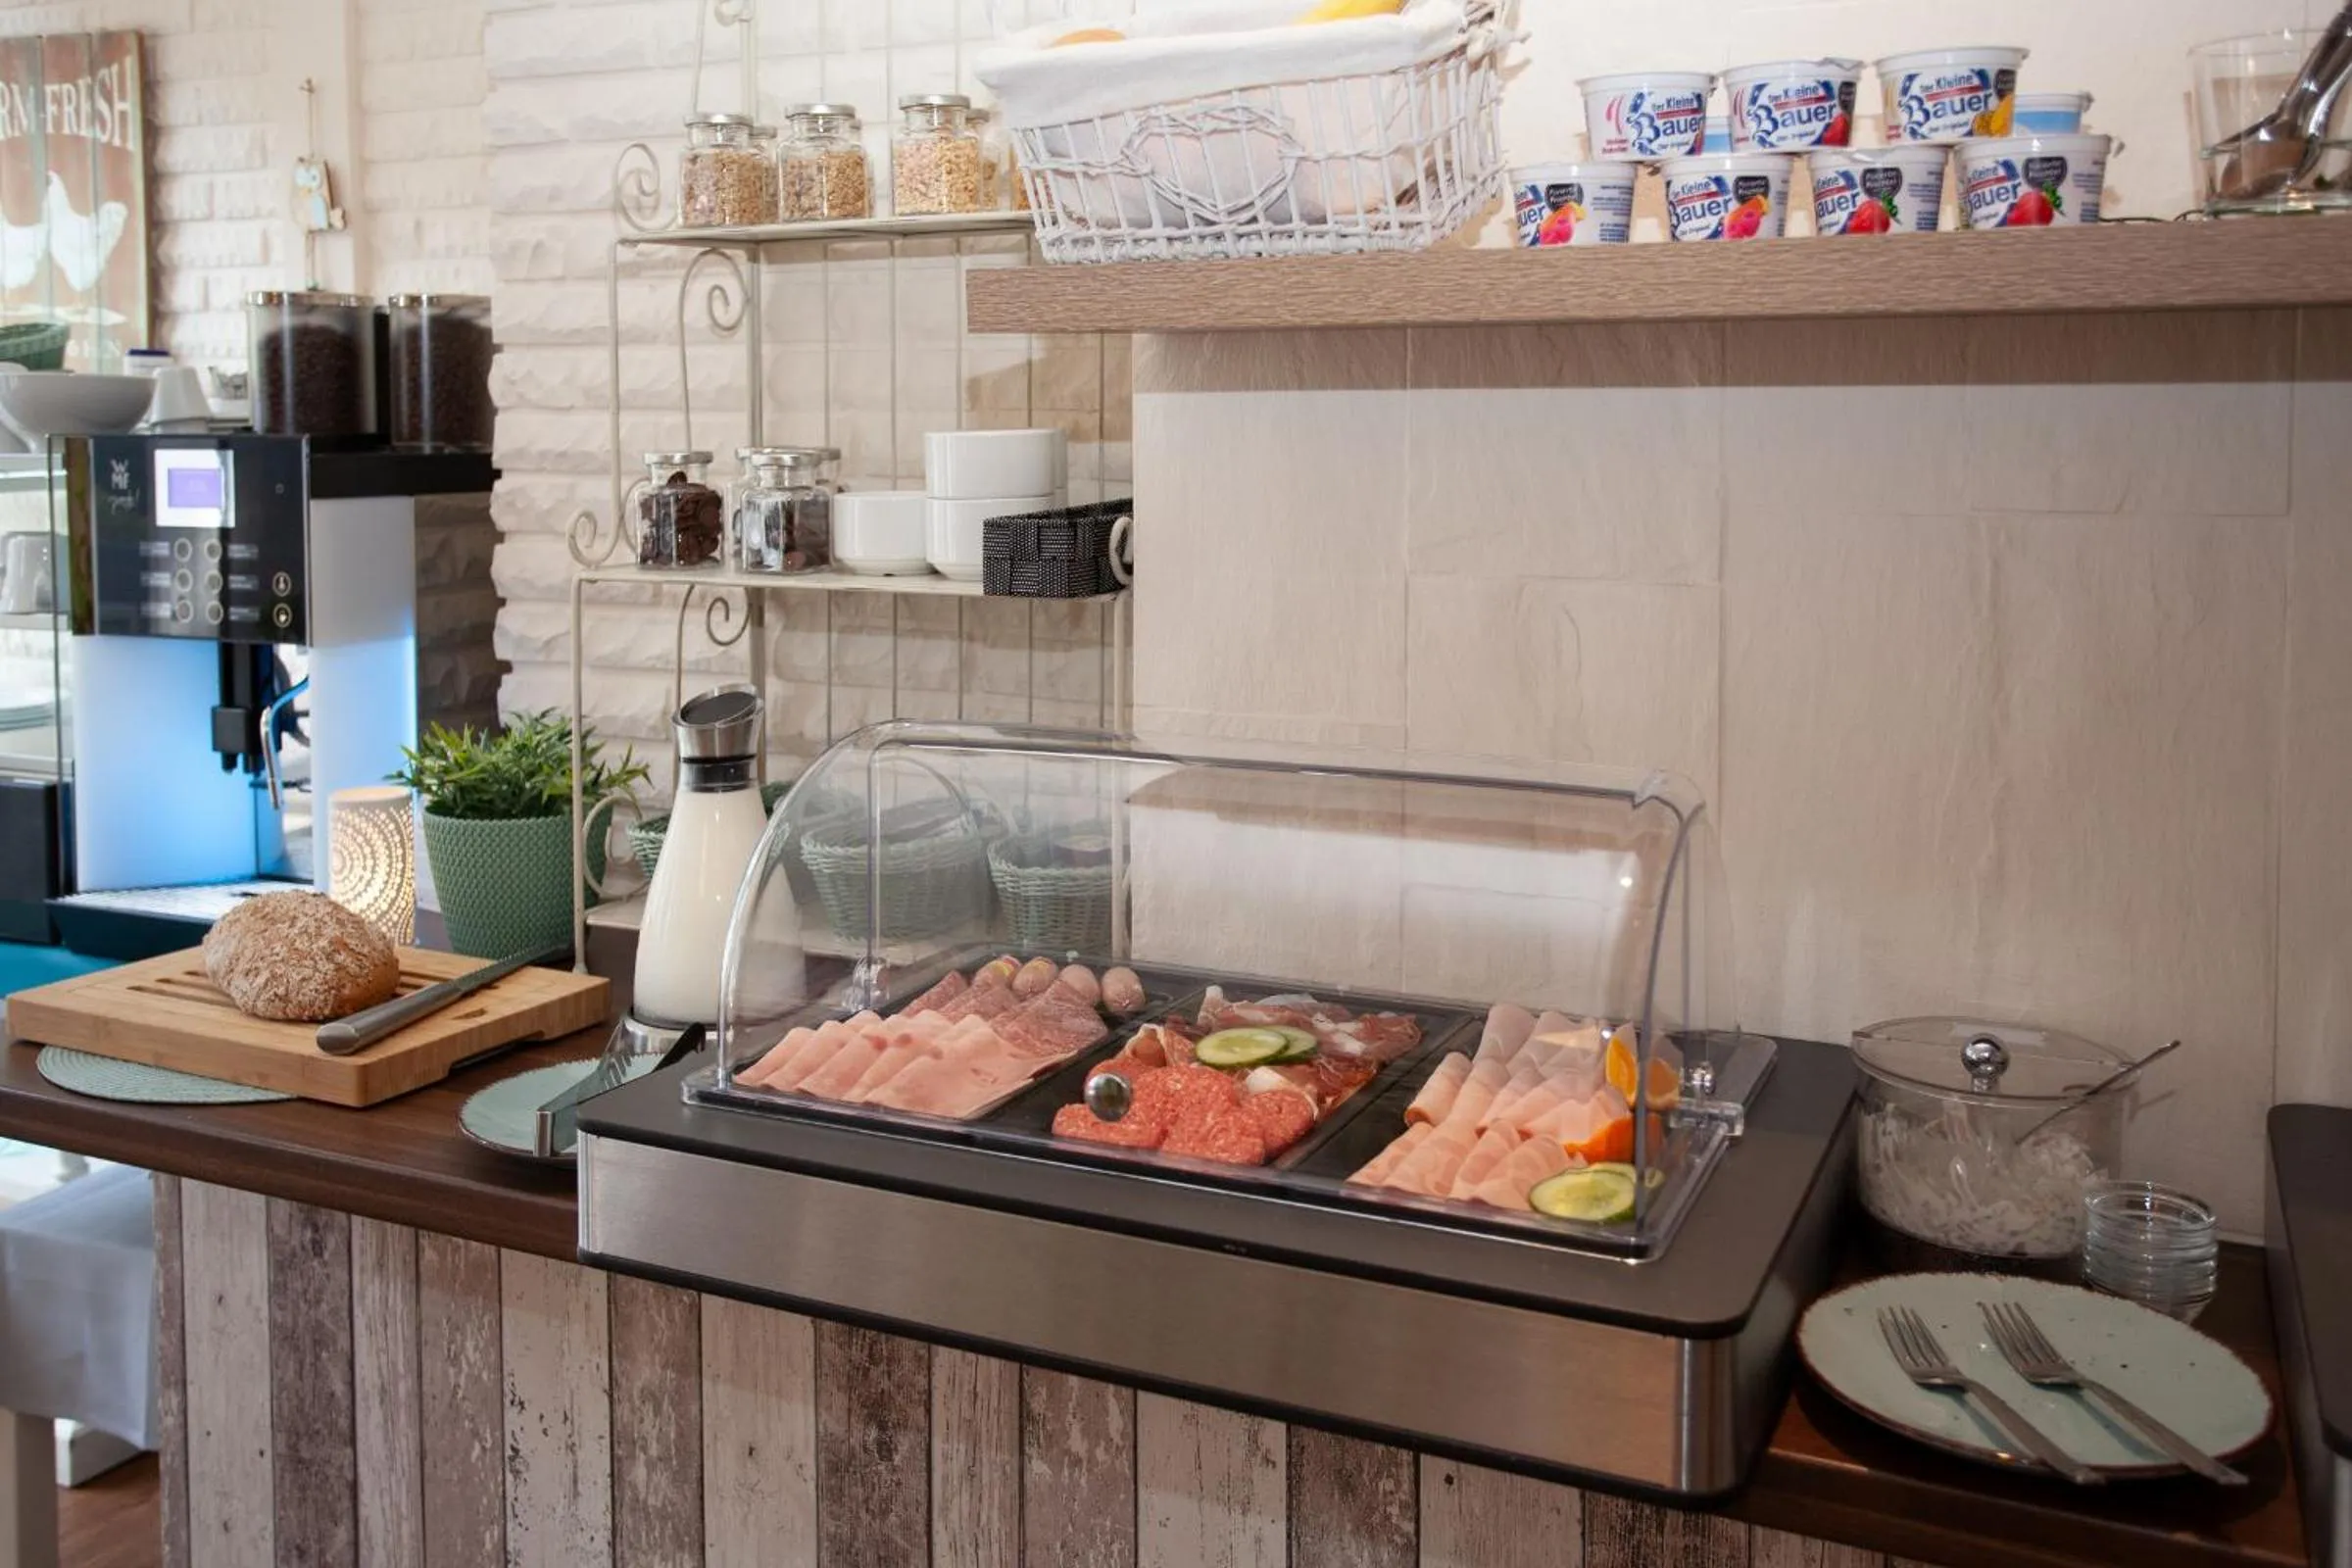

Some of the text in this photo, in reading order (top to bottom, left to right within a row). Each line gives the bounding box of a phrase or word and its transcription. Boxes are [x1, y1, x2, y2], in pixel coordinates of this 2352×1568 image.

[44, 56, 136, 151] FRESH
[1747, 103, 1837, 135] Bauer
[1898, 92, 1992, 127] Bauer
[1816, 192, 1860, 219] auer
